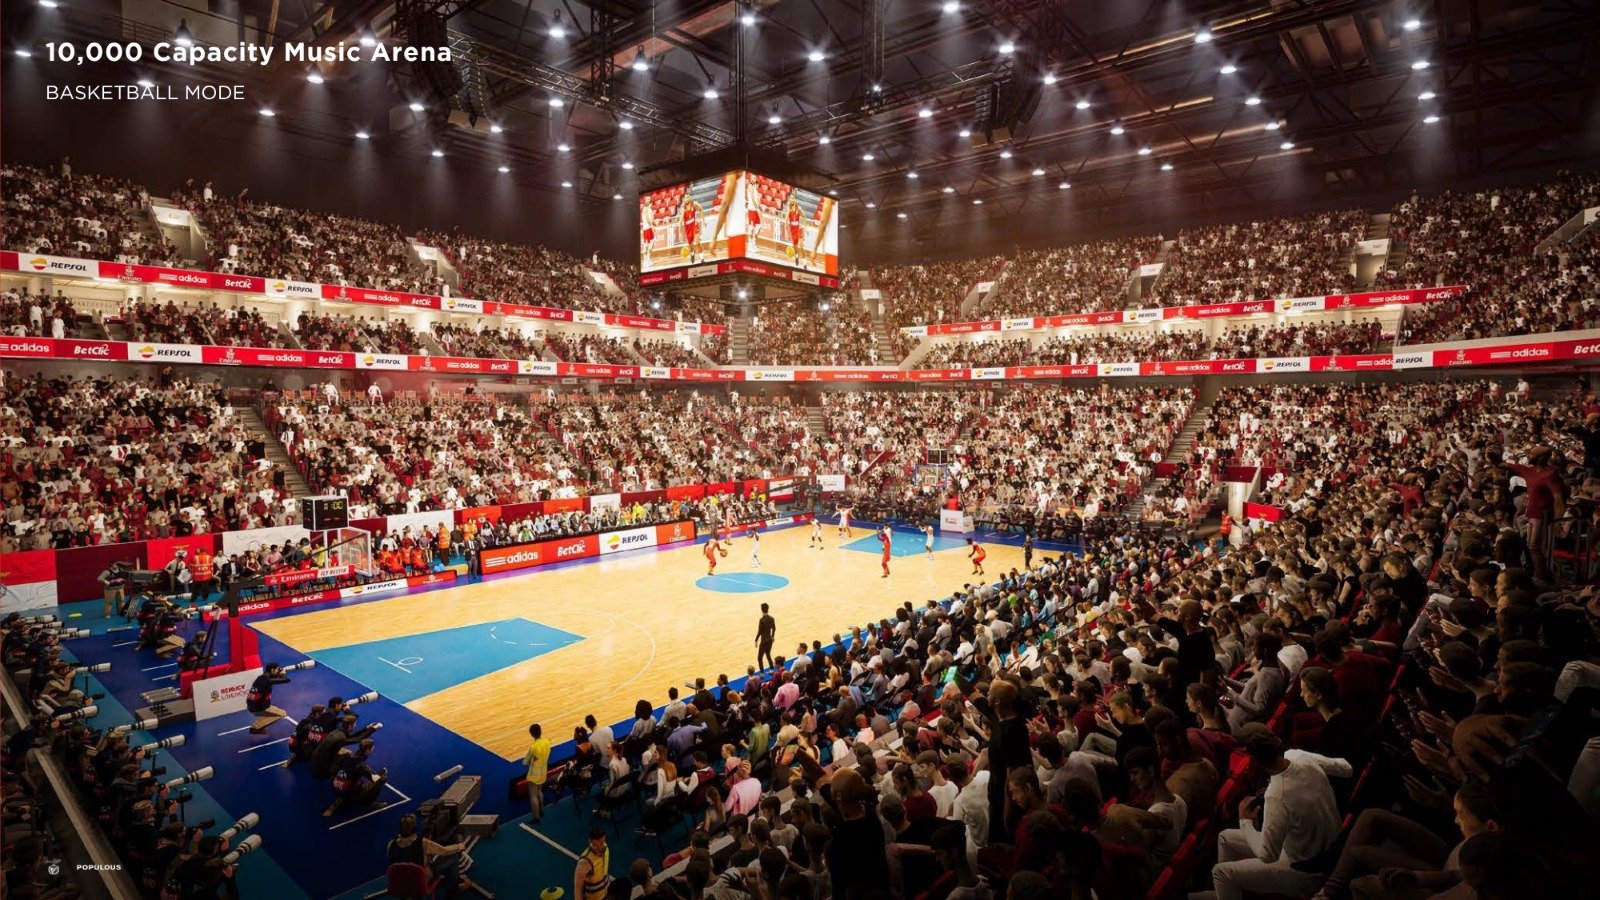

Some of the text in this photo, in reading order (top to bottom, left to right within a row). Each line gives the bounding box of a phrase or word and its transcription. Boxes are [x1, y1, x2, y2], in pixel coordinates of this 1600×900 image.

[50, 262, 88, 272] REPSOL
[178, 273, 207, 284] adidas
[225, 279, 252, 289] BetClic
[287, 285, 313, 294] REPSOL
[377, 295, 399, 303] adidas
[1384, 294, 1410, 303] adidas
[10, 341, 50, 353] adidas
[73, 344, 110, 356] BetClic
[1512, 347, 1549, 357] adidas
[157, 349, 191, 357] REPSOL
[275, 354, 302, 363] adidas
[319, 355, 344, 364] BetClic
[622, 534, 648, 545] REPSOL
[557, 540, 585, 557] BetClic
[507, 550, 538, 564] adidas
[281, 572, 315, 582] Emirates
[367, 582, 397, 591] REPSOL
[291, 592, 323, 604] BetClic
